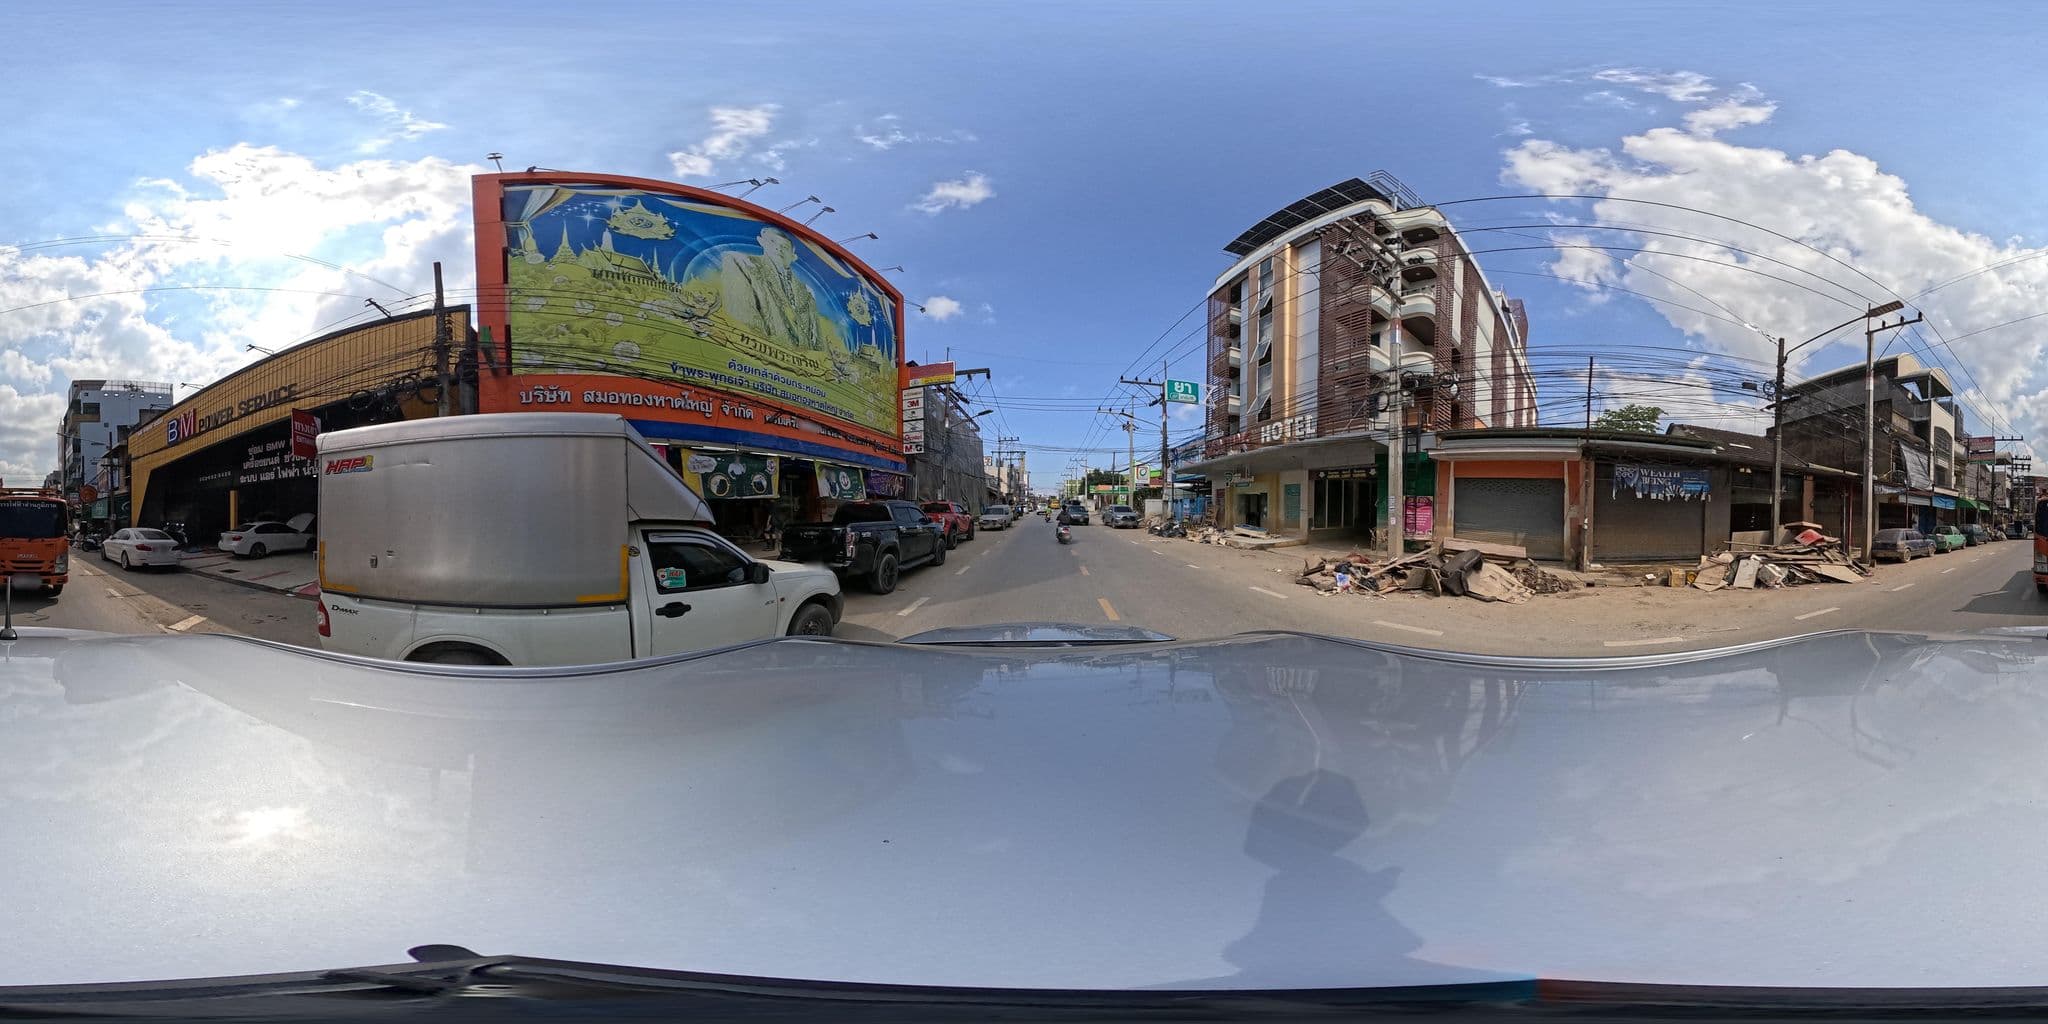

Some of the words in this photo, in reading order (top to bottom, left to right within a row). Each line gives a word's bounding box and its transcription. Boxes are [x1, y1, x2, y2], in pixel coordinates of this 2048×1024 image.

[739, 333, 820, 369] ทรงพระเจริญ
[670, 361, 751, 387] ข้าพระพุทธเจ้า
[727, 358, 827, 398] ด้วยเกล้าด้วยกระหม่อม
[1174, 382, 1192, 394] ยา
[167, 408, 197, 447] BM
[198, 407, 234, 433] POWER
[238, 383, 298, 415] SERVICE
[520, 384, 572, 405] บริษัท
[583, 389, 714, 418] สมอทองหาดใหญ่
[721, 399, 754, 420] จำกัด
[907, 399, 920, 408] 3M
[1261, 414, 1316, 444] HOTEL
[266, 440, 285, 451] BMW
[1640, 468, 1680, 478] WEALTH
